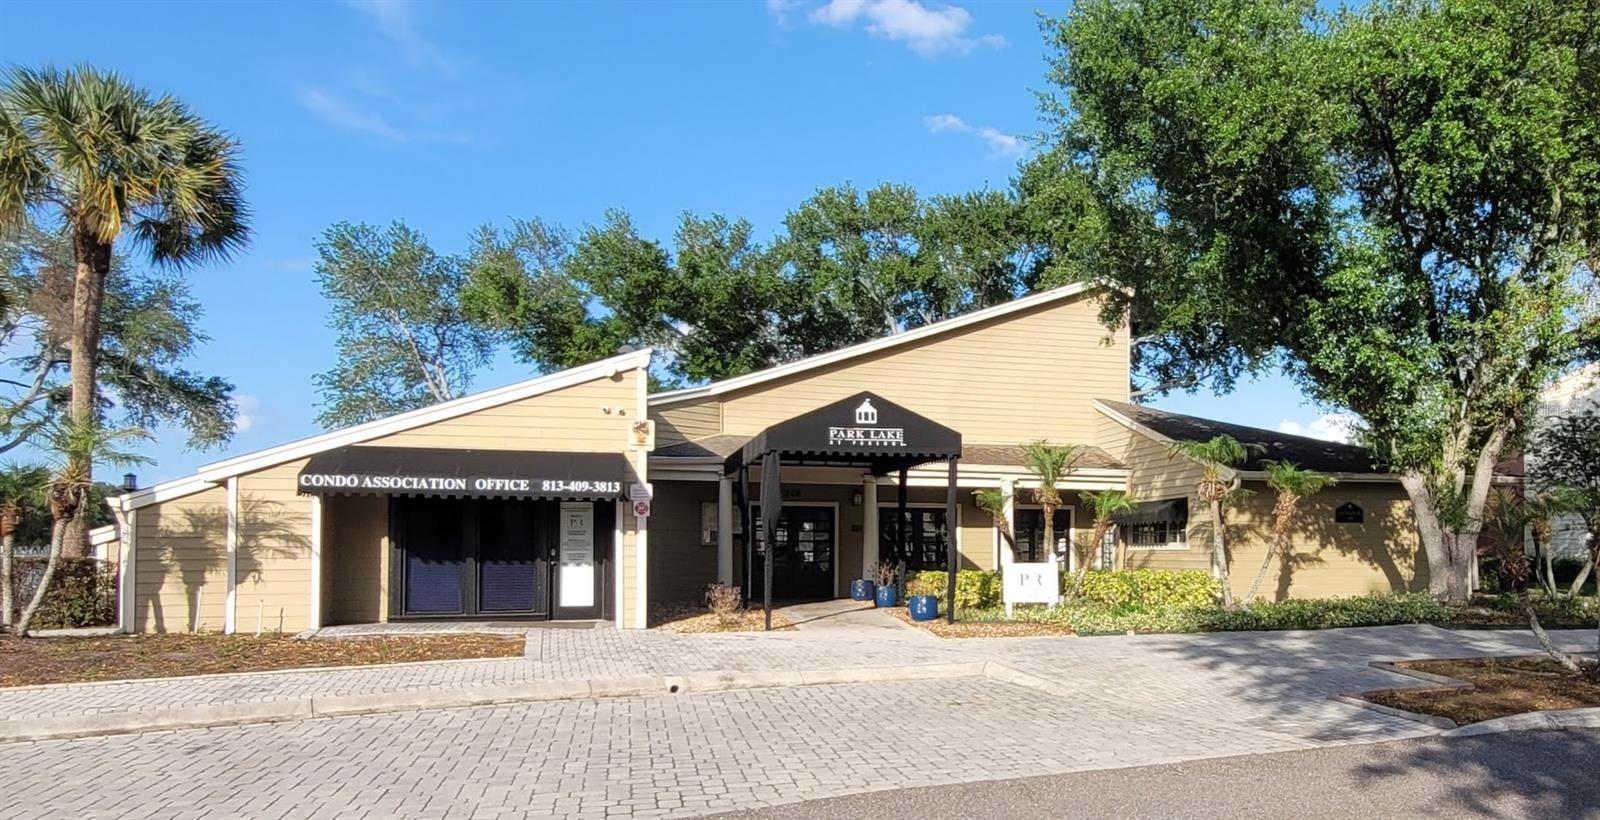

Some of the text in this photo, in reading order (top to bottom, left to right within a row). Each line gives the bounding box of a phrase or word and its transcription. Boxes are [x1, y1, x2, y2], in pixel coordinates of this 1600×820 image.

[829, 429, 904, 439] PARK LAKE
[300, 474, 621, 493] CONDO ASSOCIATION OFFICE 813-409-3813
